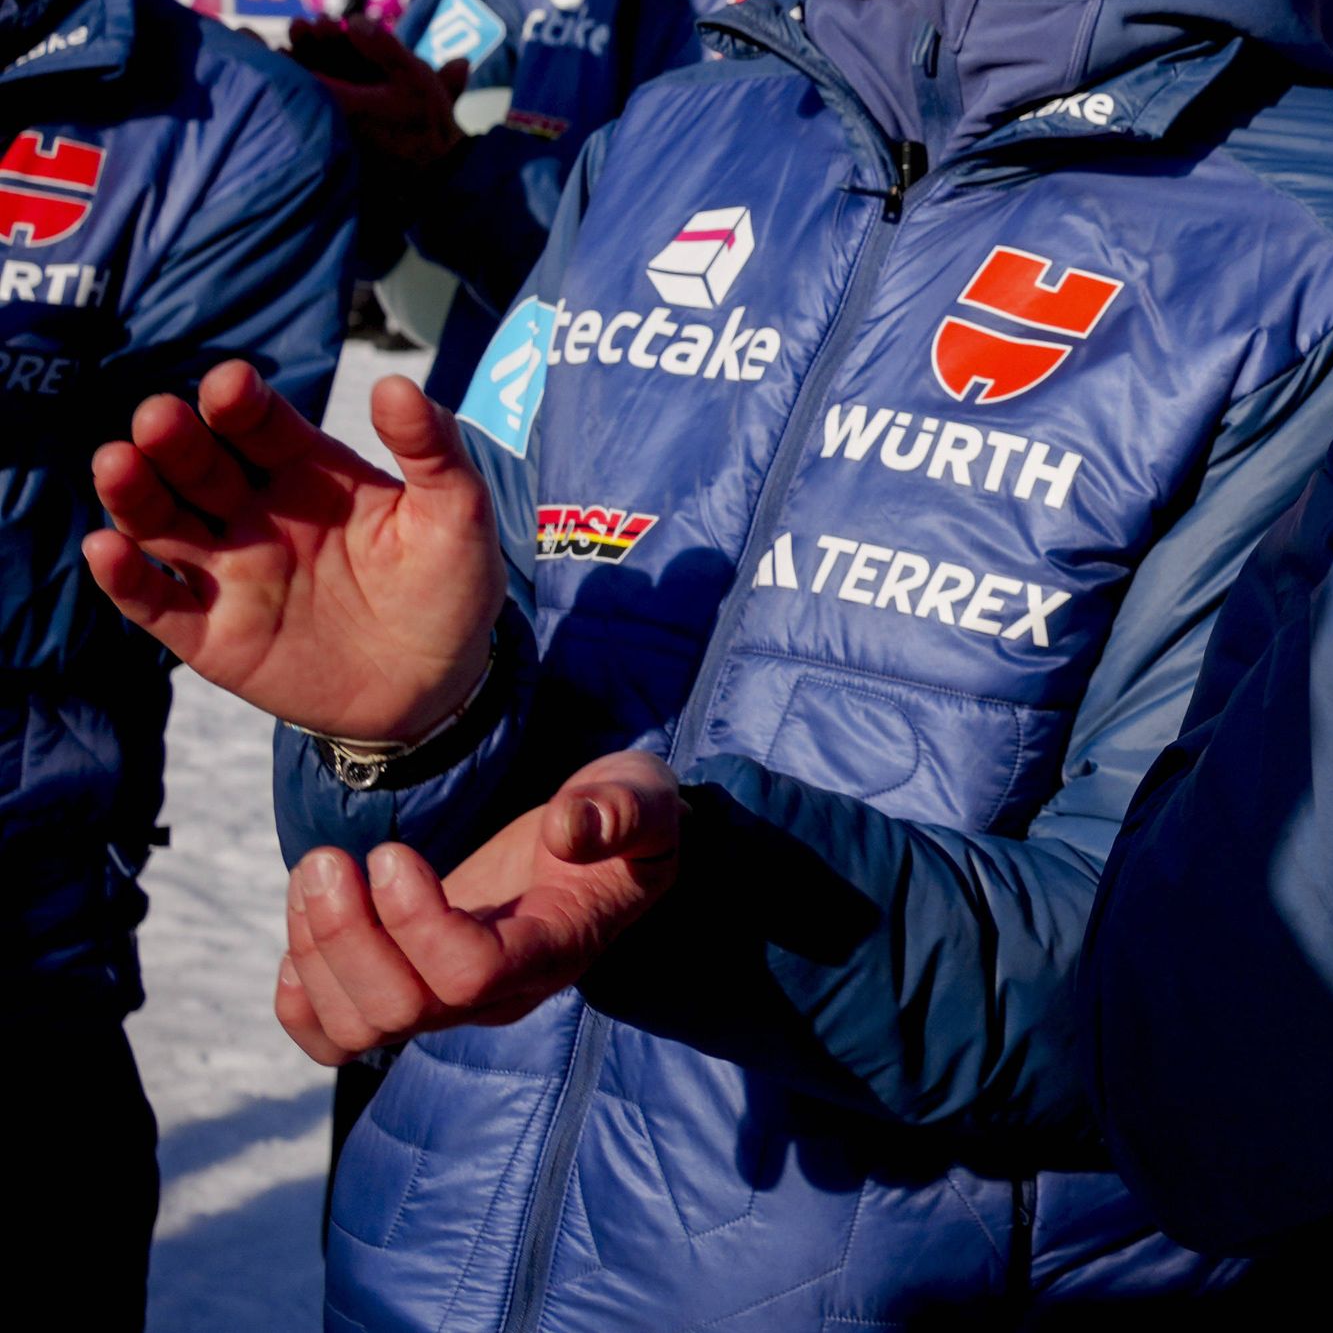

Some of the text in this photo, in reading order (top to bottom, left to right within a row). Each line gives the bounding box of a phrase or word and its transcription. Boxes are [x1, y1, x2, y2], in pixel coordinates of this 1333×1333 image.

[547, 298, 781, 381] tectake
[820, 404, 1083, 509] WÜRTH
[811, 535, 1072, 648] TERREX
